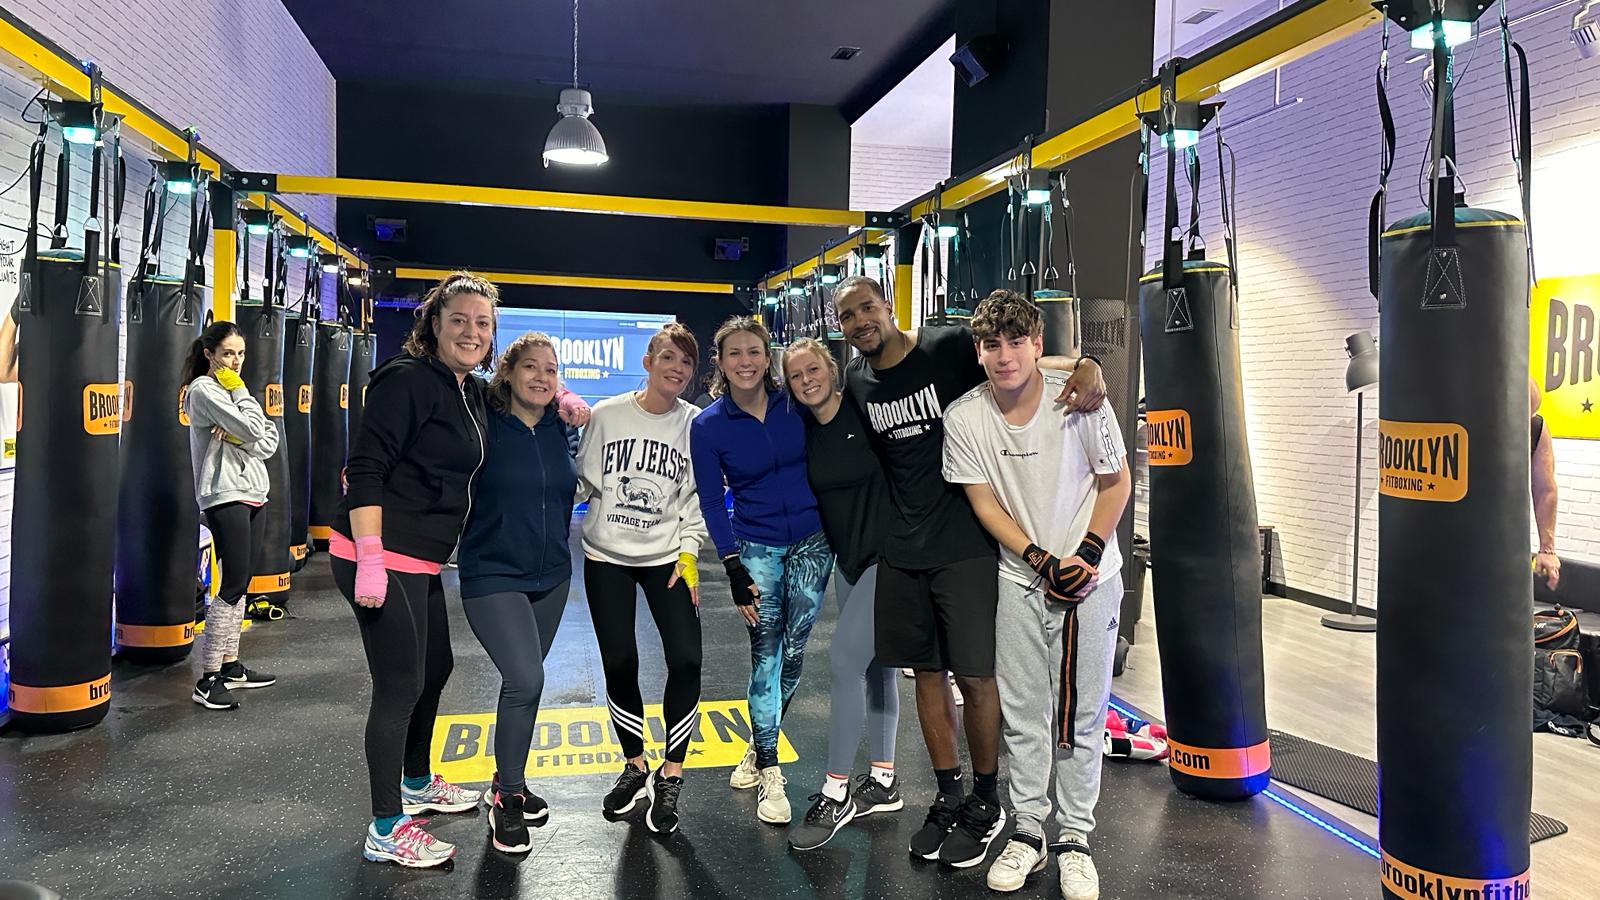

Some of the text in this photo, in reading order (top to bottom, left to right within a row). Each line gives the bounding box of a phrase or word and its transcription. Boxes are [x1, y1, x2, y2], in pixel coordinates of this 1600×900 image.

[1545, 298, 1600, 393] BR
[866, 383, 943, 434] BROOKLYN
[601, 438, 637, 475] EW
[1000, 449, 1039, 460] Champion
[1385, 474, 1423, 492] FITBOXING
[606, 513, 662, 529] VINTAGE TEAM
